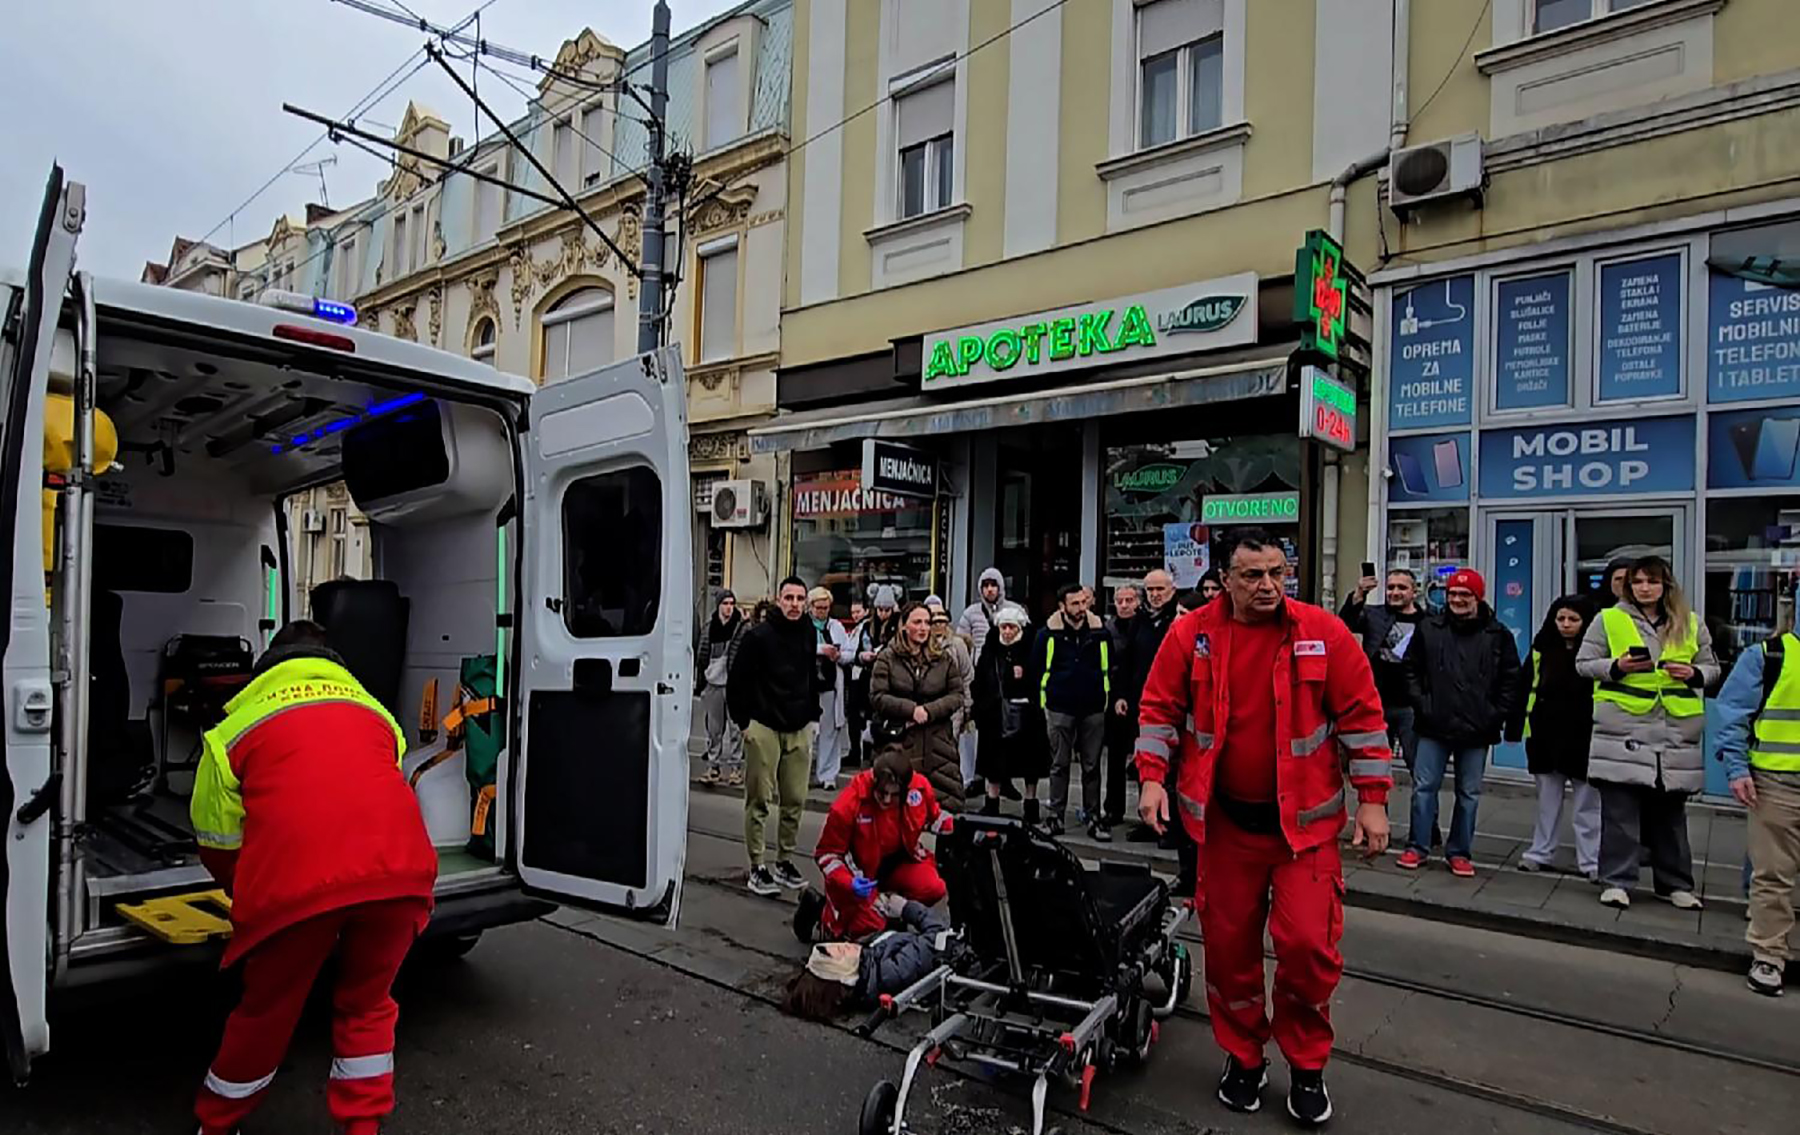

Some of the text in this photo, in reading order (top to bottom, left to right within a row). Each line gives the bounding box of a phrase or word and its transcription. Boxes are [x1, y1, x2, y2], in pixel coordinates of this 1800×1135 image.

[1621, 274, 1659, 288] ZAMENA
[1620, 285, 1655, 299] STAKLA
[1621, 295, 1659, 309] EKRANA
[1730, 292, 1800, 318] SERVIS
[1157, 299, 1233, 333] LAURUS
[1621, 310, 1659, 323] ZAMENA
[1719, 317, 1800, 343] MOBILNI
[925, 305, 1157, 381] APOTEKA
[1403, 338, 1461, 359] OPREMA
[1422, 361, 1440, 377] ZA
[1718, 371, 1723, 388] I
[1401, 378, 1462, 398] MOBILNE
[1395, 397, 1467, 418] TELEFONE
[1513, 426, 1649, 459] MOBIL
[879, 455, 932, 485] MENJAČNICA
[1114, 468, 1177, 489] LAURUS
[1513, 460, 1649, 491] SHOP
[796, 483, 906, 513] MENJAČNICA
[1204, 497, 1297, 519] OTVORENO
